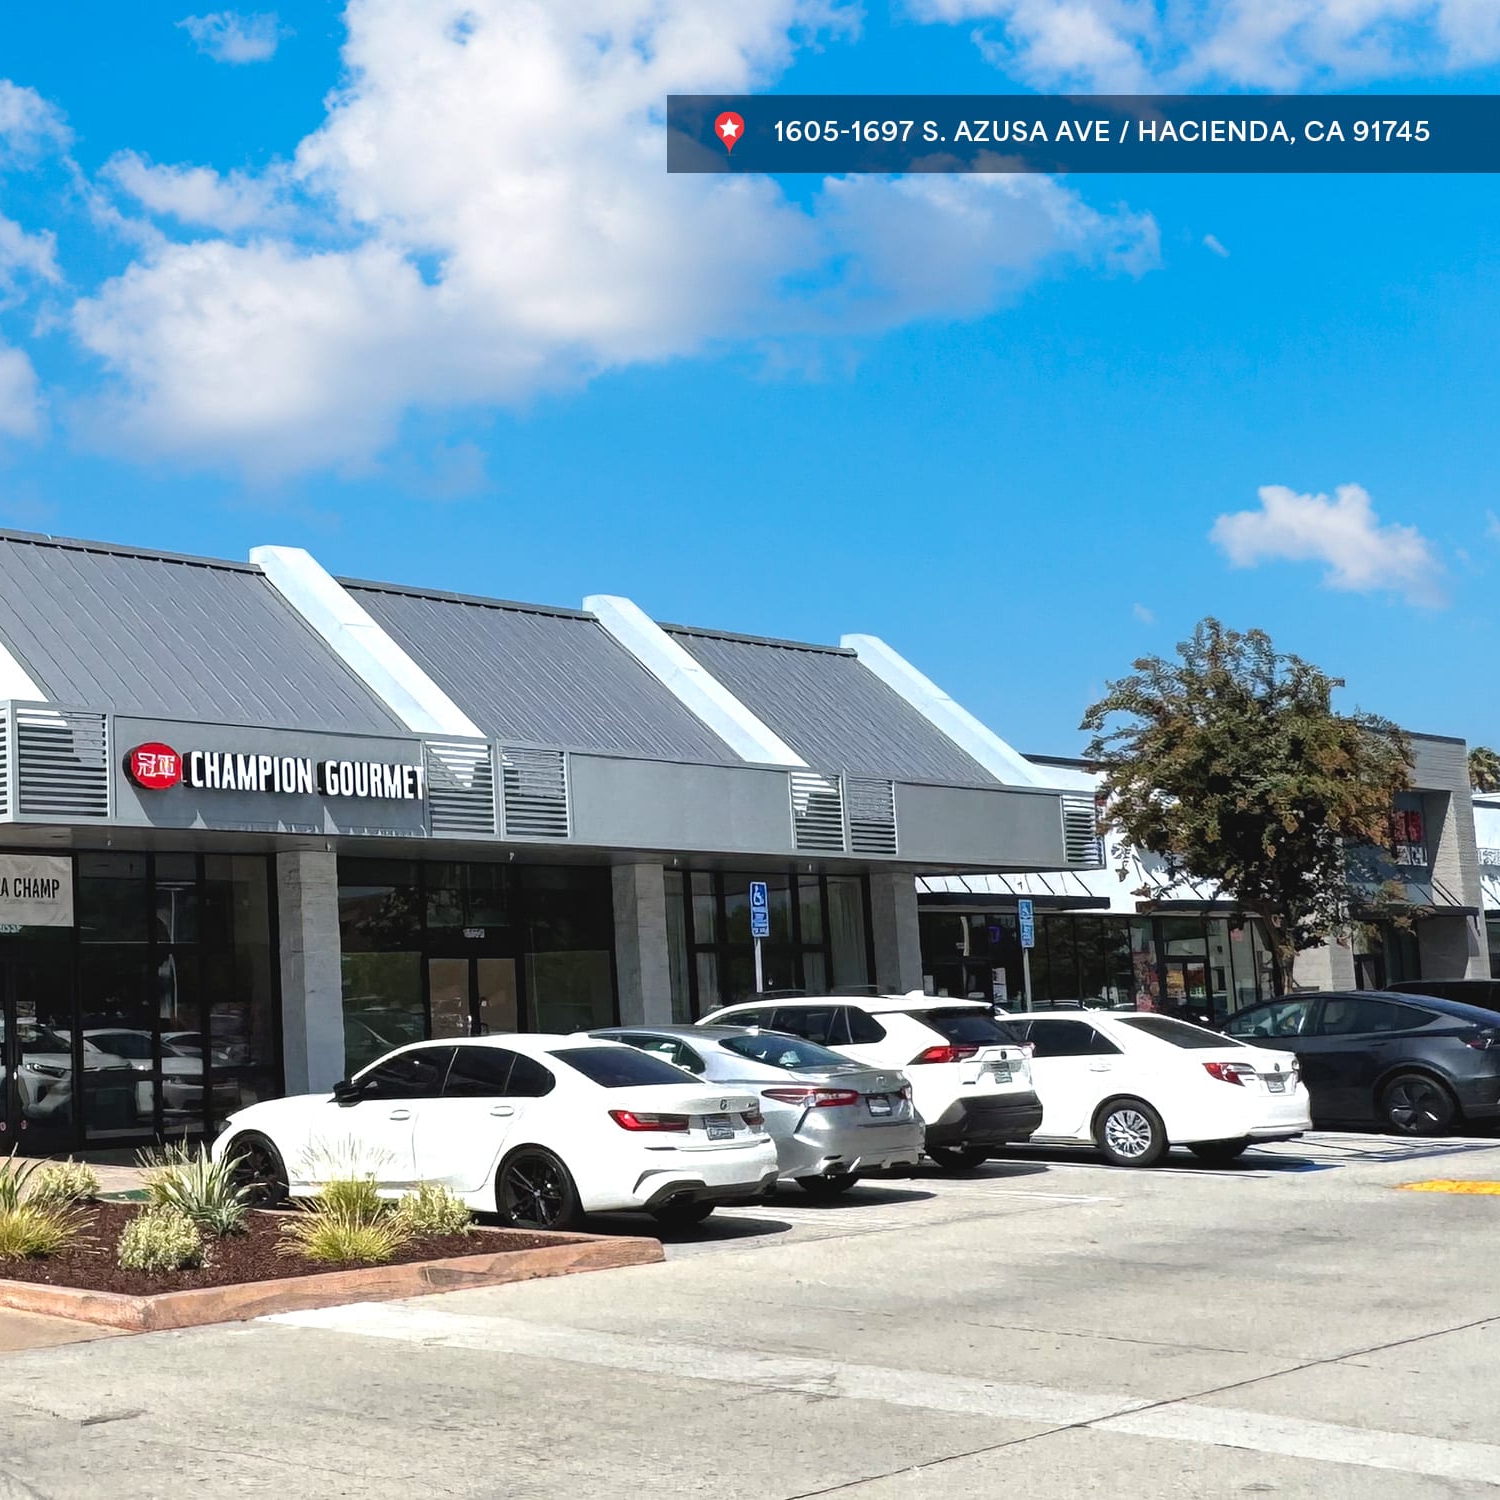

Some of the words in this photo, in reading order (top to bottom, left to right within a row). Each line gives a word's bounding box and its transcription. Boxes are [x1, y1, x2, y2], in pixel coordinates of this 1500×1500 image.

[190, 750, 313, 794] CHAMPION
[325, 760, 424, 801] GOURMET
[13, 877, 60, 899] CHAMP
